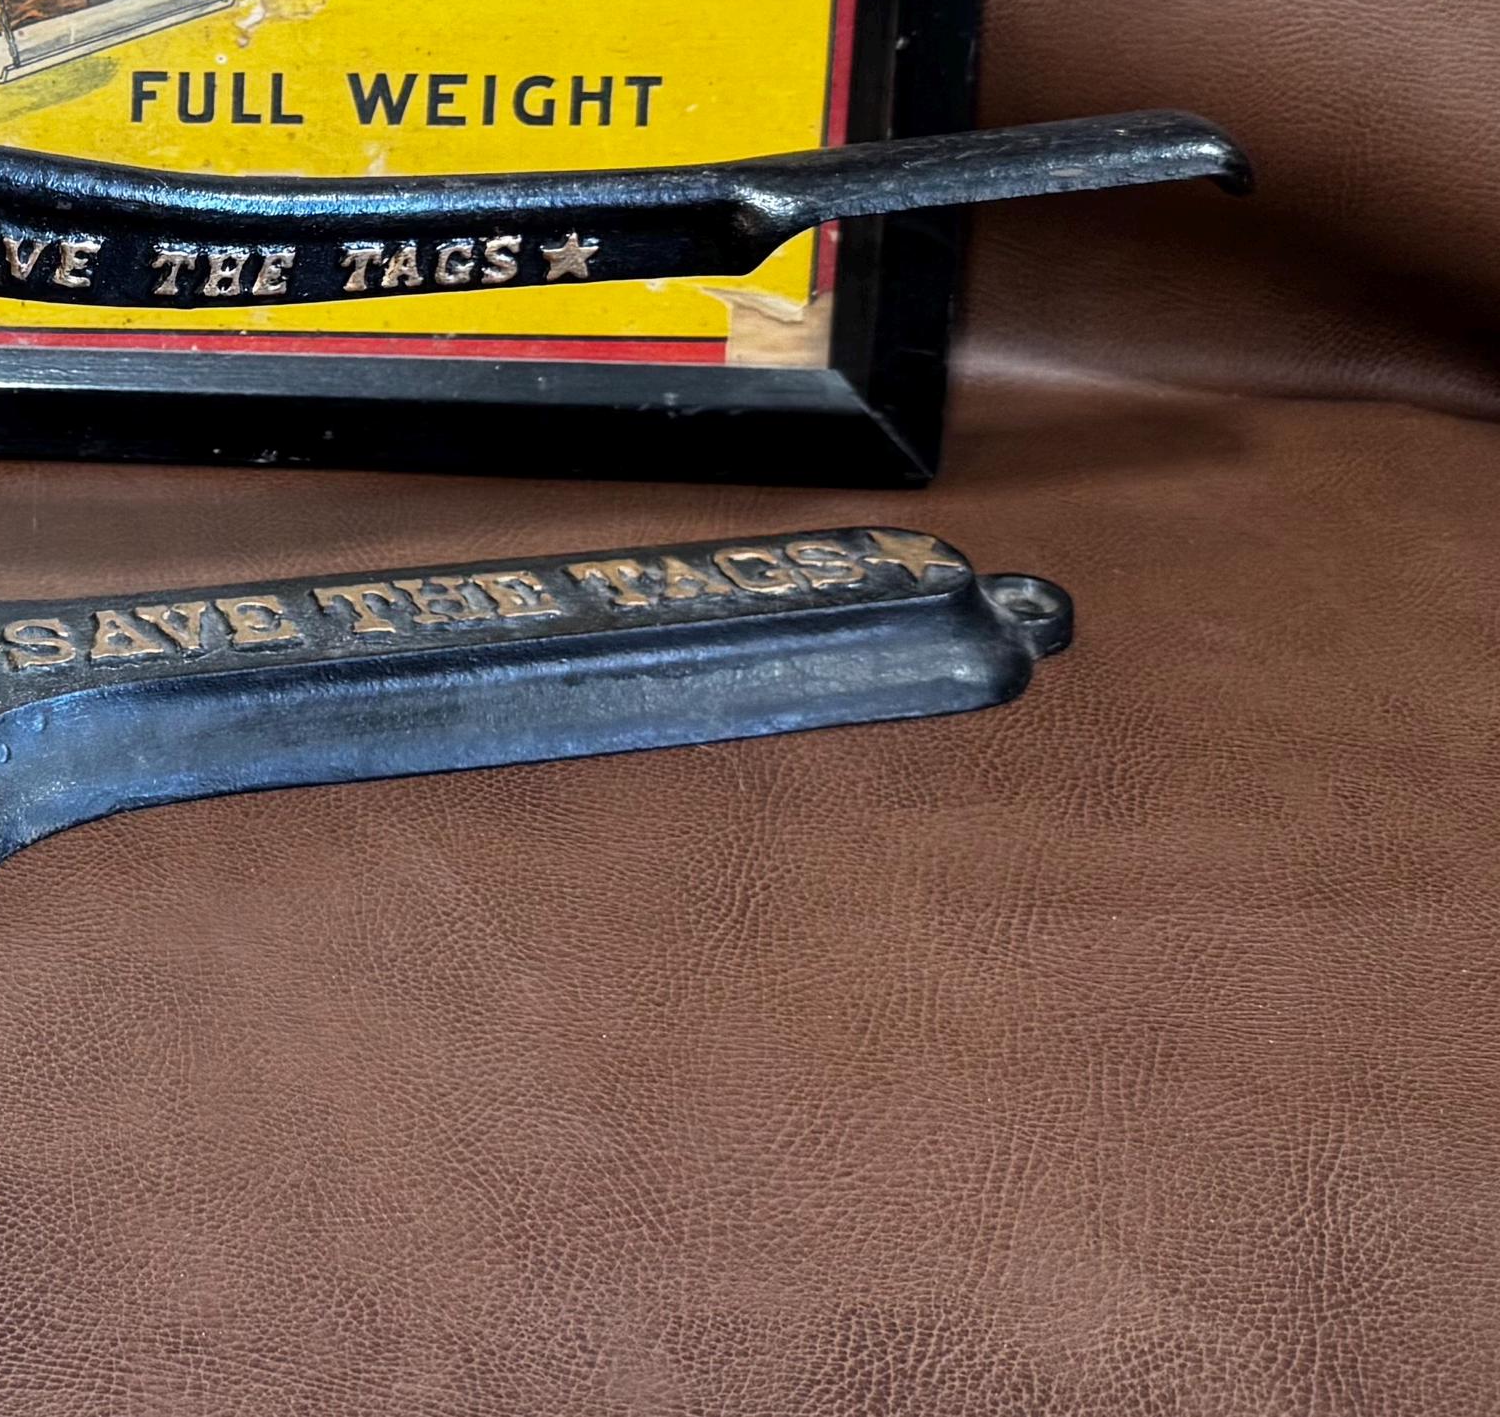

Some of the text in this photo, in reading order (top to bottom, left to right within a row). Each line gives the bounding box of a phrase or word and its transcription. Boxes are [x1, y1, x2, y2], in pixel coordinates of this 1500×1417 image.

[131, 70, 664, 129] FULL WEIGHT
[150, 242, 297, 298] THE
[339, 232, 525, 290] TAGS
[2, 539, 867, 670] SAVE THE TAGS
